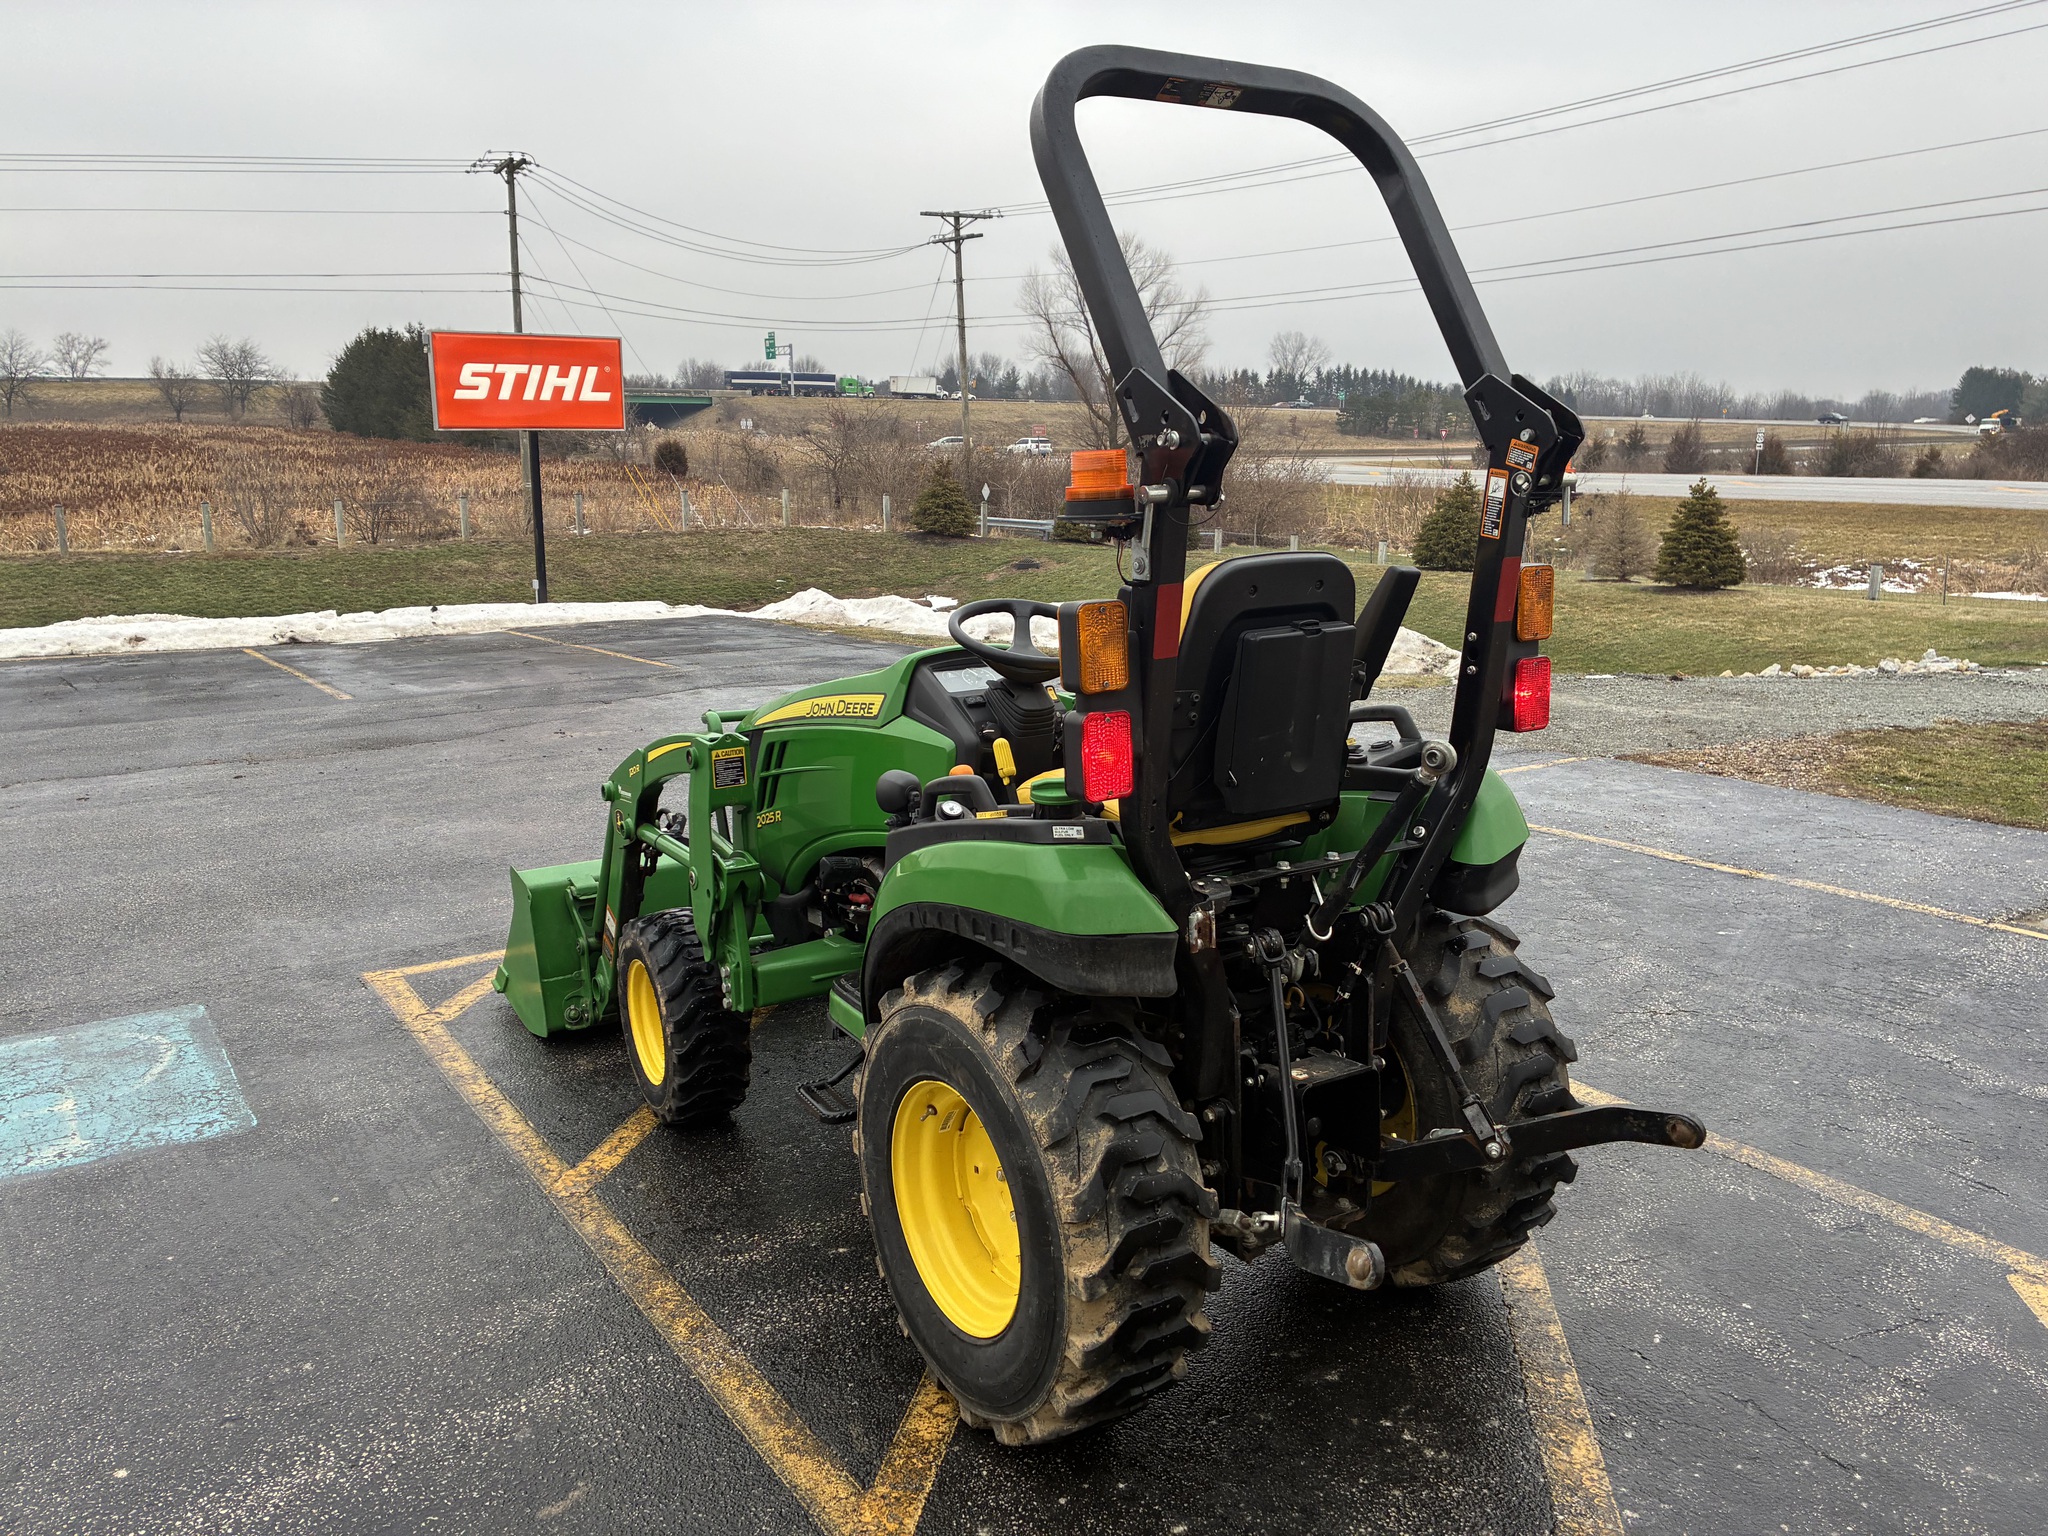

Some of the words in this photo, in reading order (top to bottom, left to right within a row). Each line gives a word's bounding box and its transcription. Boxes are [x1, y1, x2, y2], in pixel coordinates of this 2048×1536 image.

[453, 362, 611, 402] STIHL
[806, 701, 835, 716] JOHN
[837, 700, 876, 715] DEERE
[721, 748, 744, 757] CAUTION
